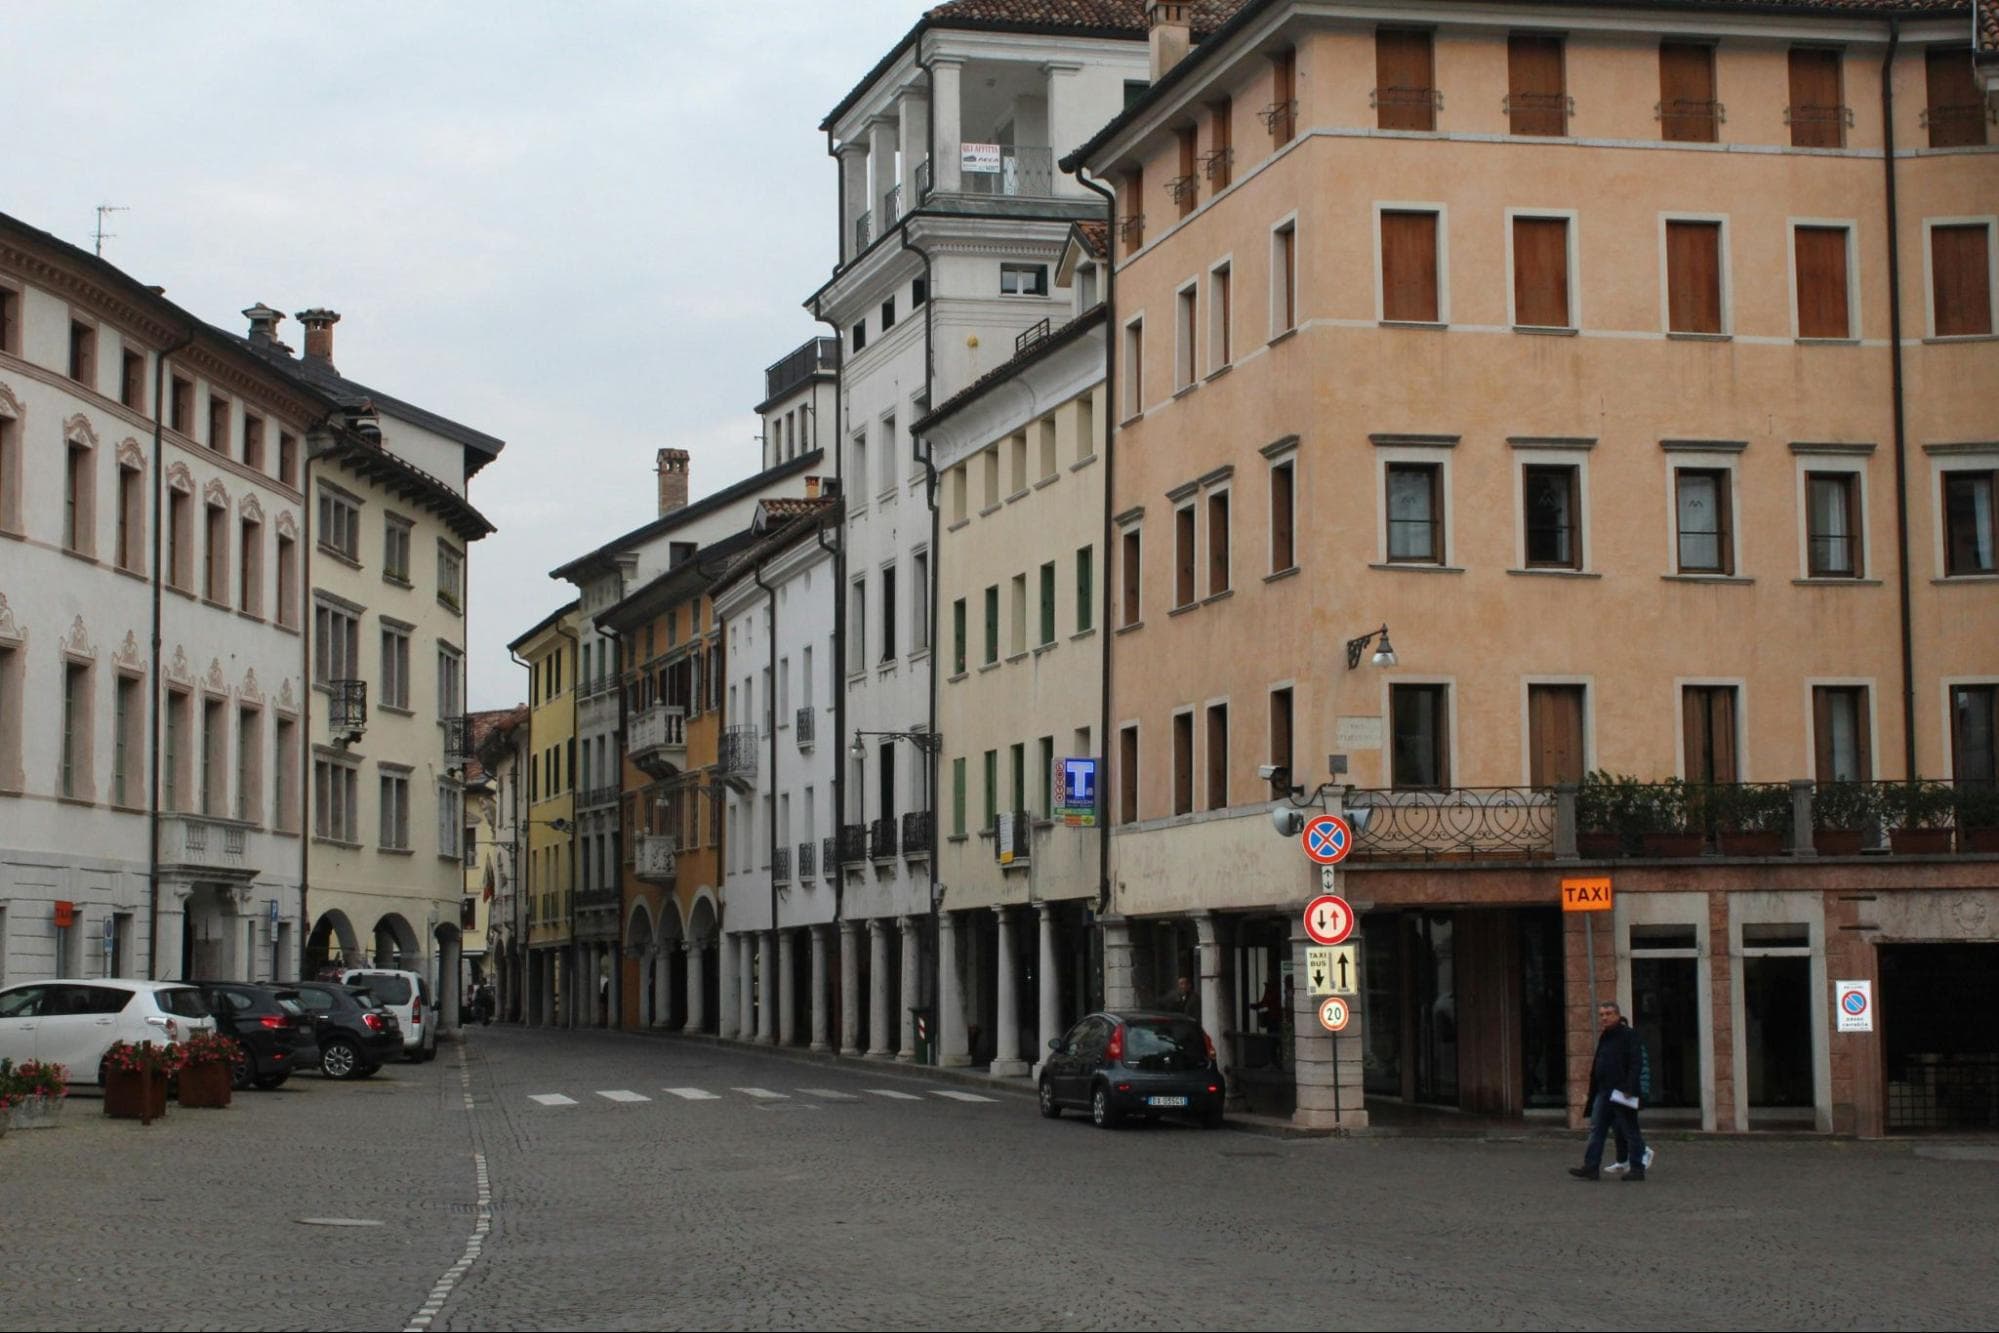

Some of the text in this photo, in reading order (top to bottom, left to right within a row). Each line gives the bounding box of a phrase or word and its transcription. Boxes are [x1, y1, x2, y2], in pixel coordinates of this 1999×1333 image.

[1056, 761, 1065, 803] LOTTO
[1067, 761, 1094, 798] T
[1564, 886, 1609, 902] TAXI
[1326, 1007, 1342, 1021] 20
